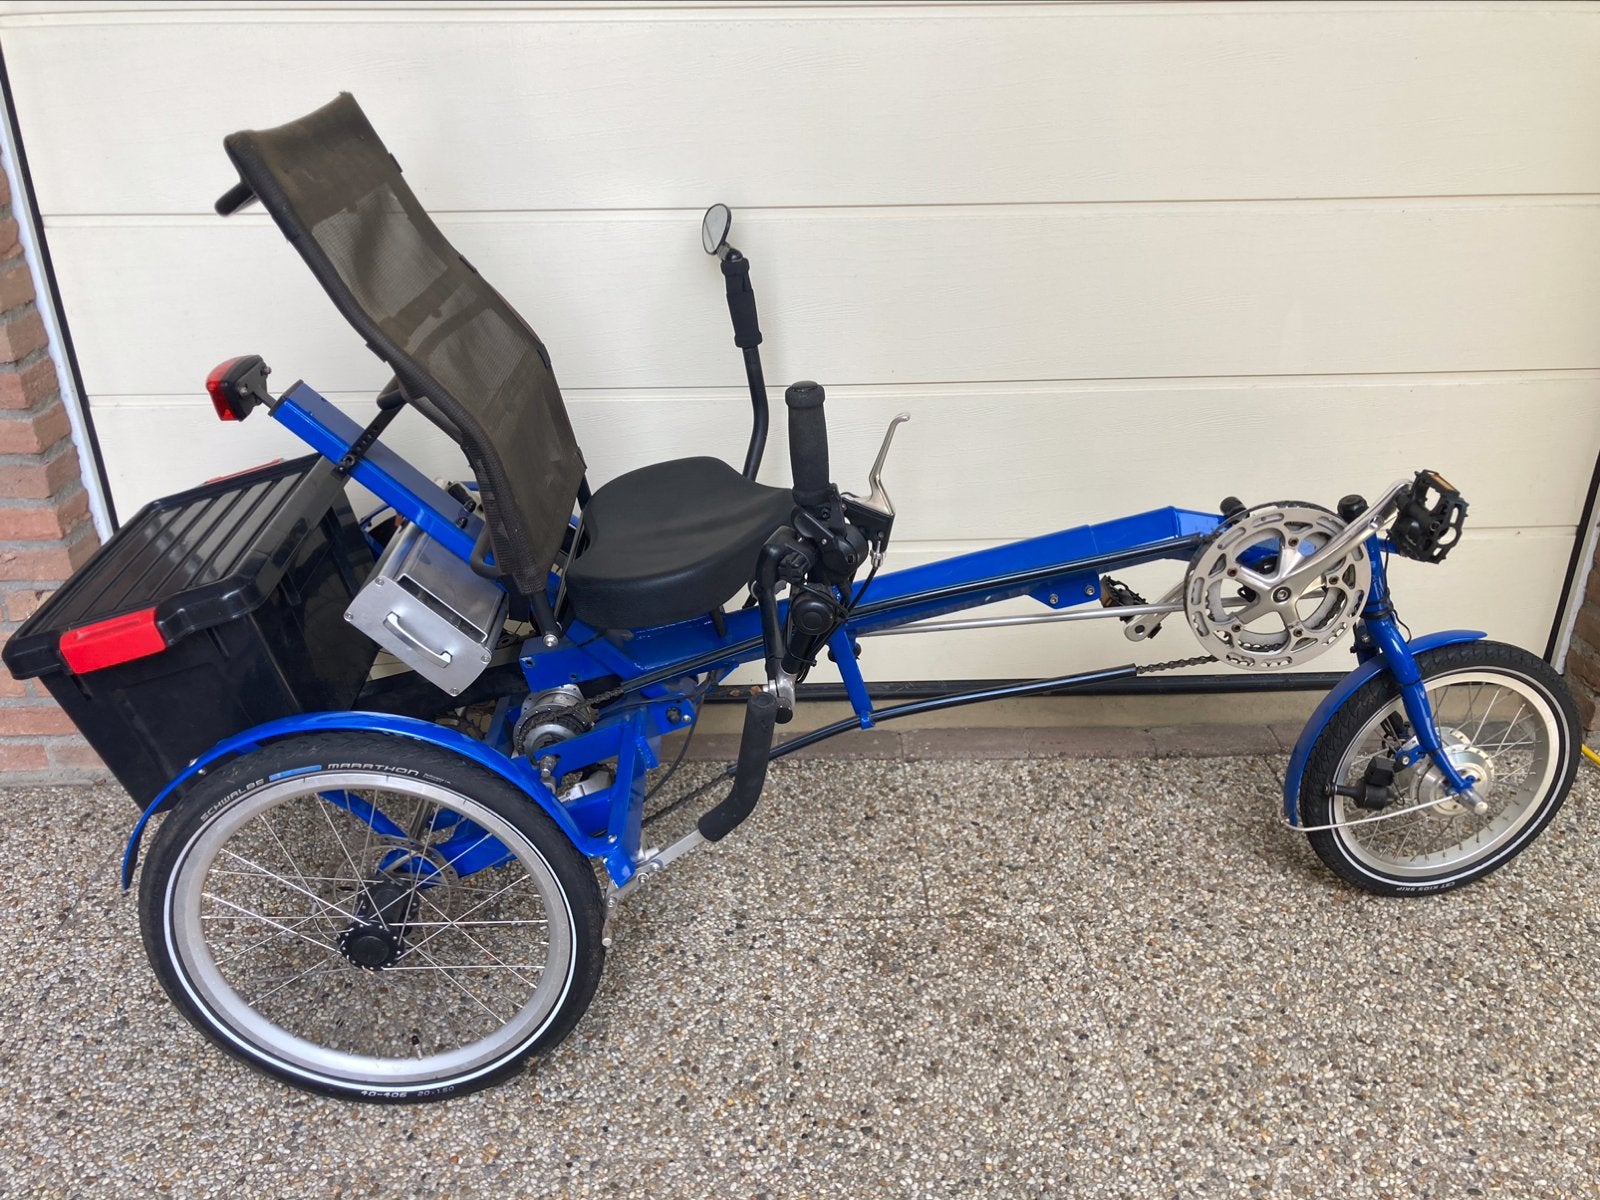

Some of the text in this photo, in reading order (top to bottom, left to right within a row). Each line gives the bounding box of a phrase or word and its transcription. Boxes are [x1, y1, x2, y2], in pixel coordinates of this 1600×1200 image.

[327, 763, 420, 776] MARATHON
[200, 778, 265, 822] SCHWALBE
[360, 1090, 408, 1098] 40-406
